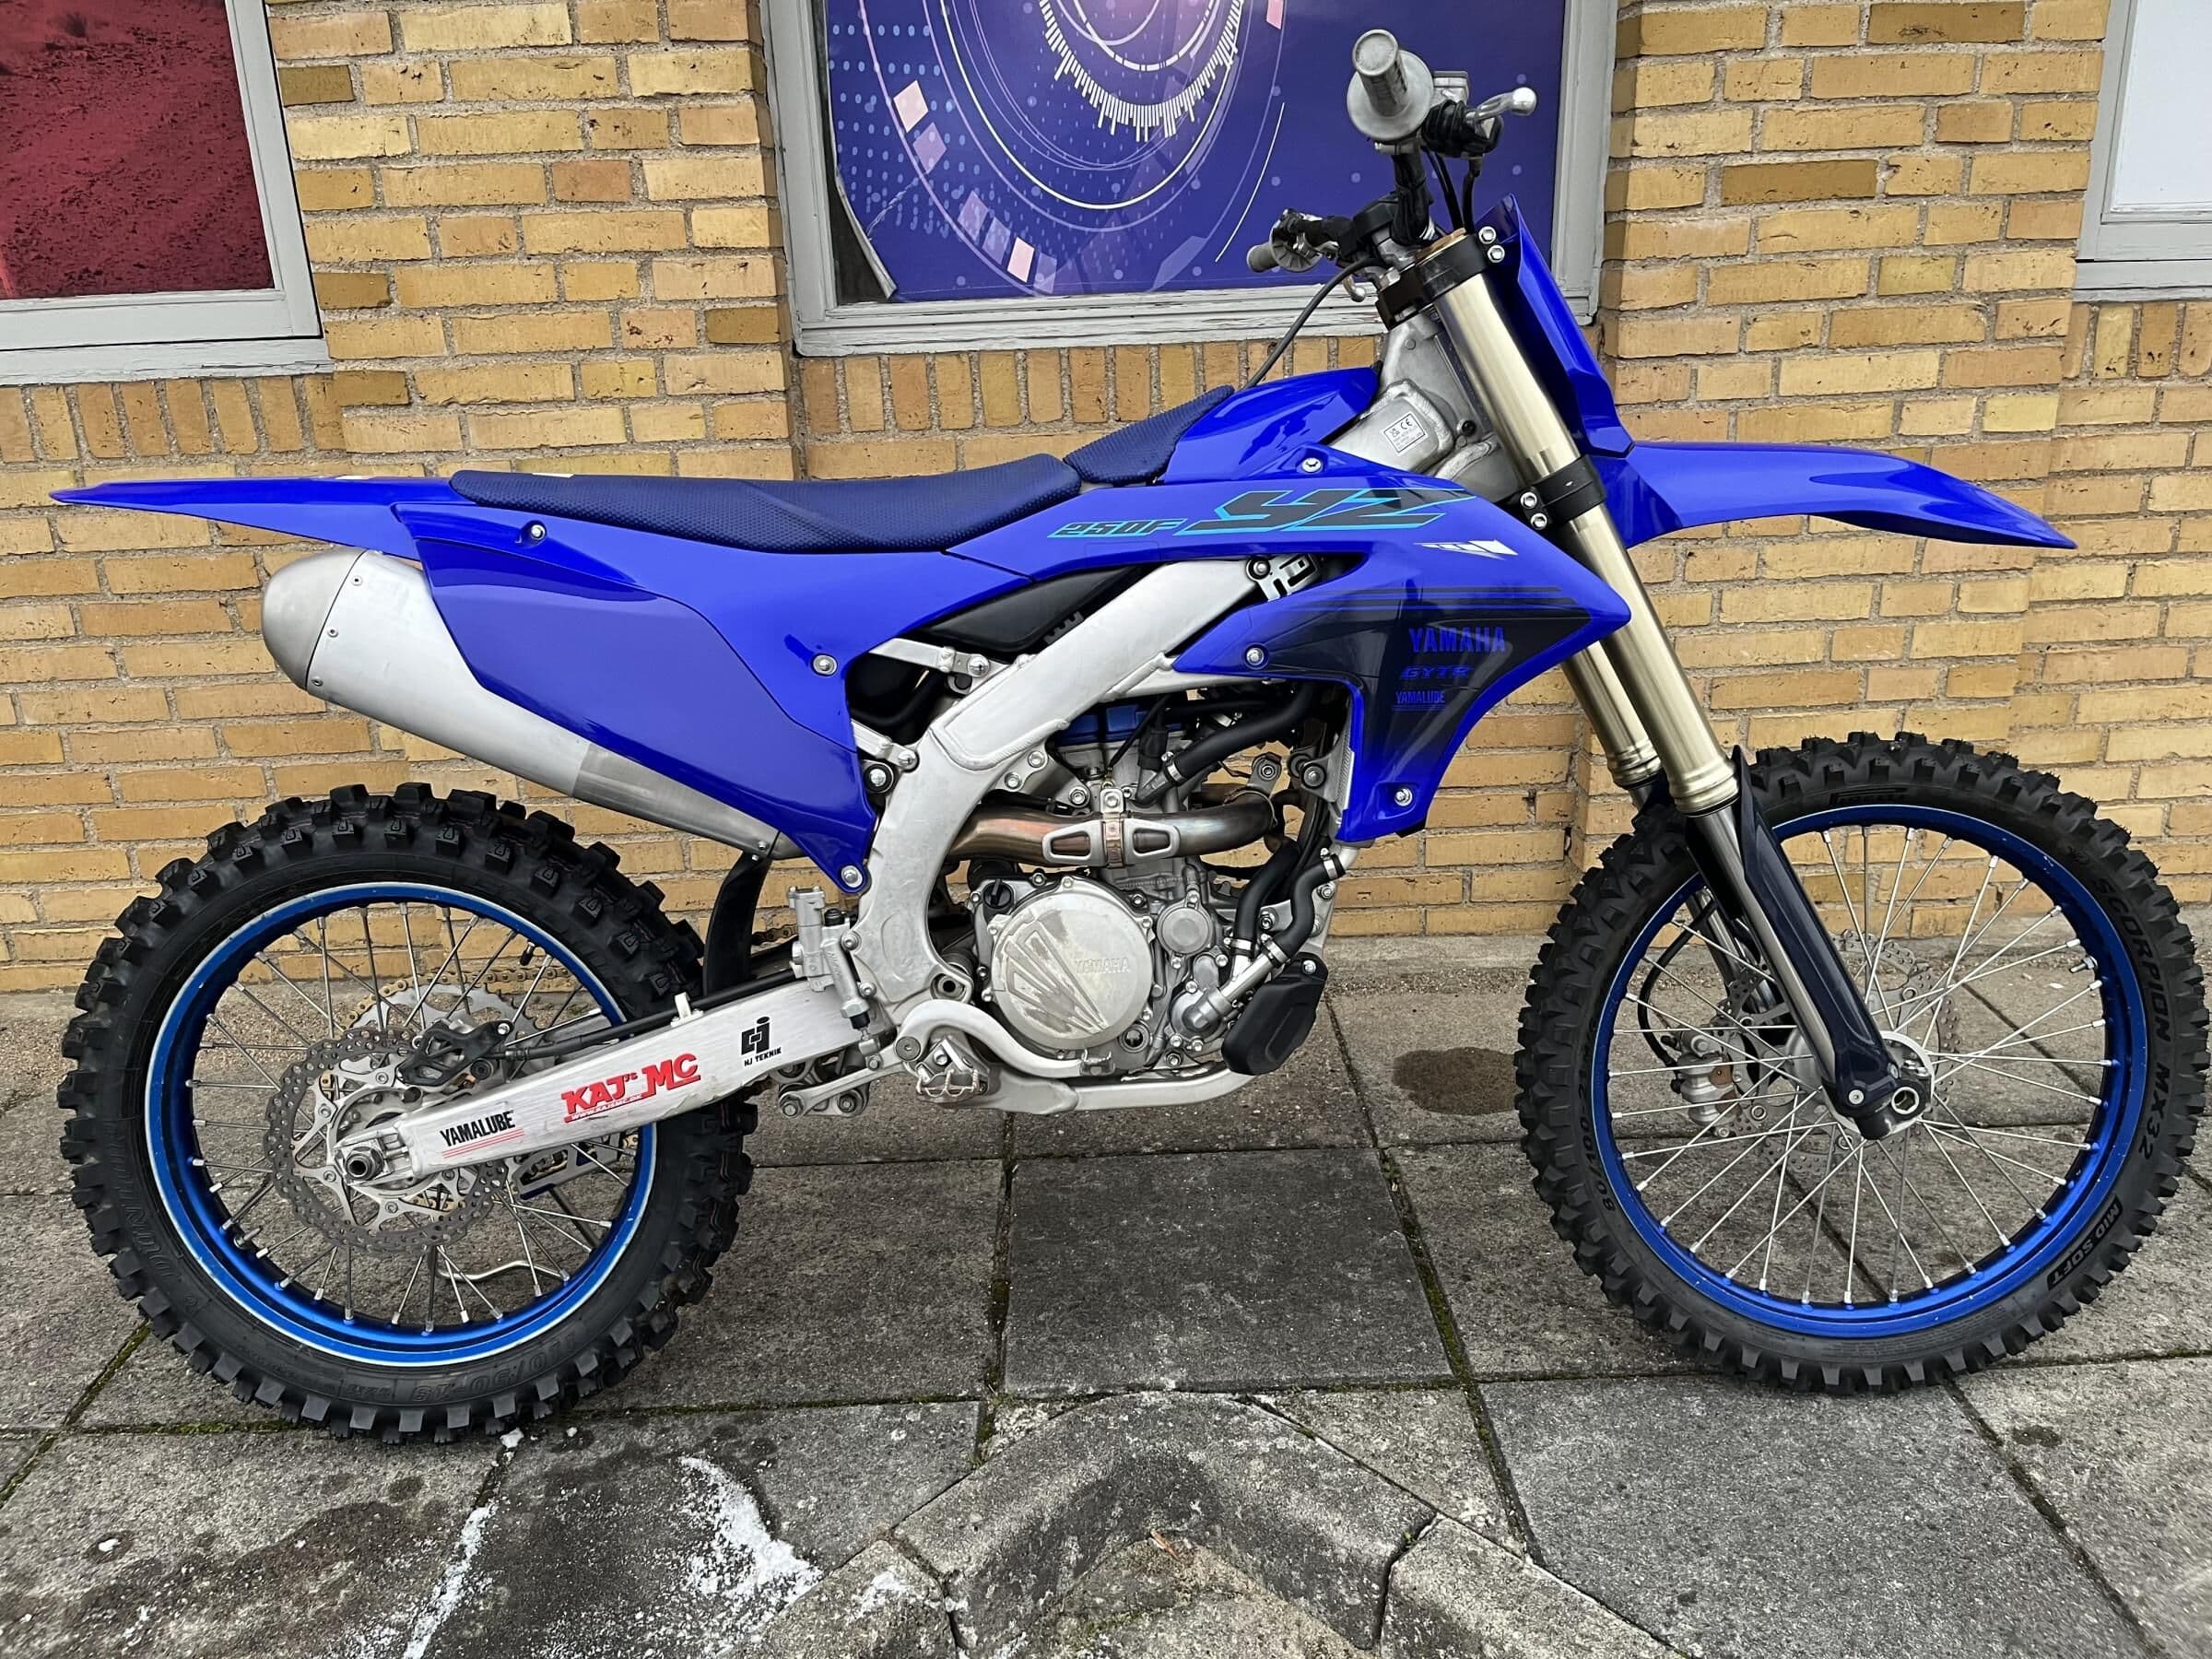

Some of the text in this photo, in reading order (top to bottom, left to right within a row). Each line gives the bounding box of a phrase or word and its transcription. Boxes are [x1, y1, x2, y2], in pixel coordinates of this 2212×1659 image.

[1047, 488, 1477, 538] 250F YZ
[1408, 626, 1506, 653] YAMAHA
[1401, 665, 1471, 679] GYTR
[1394, 689, 1446, 704] YAMALUBE
[2095, 877, 2172, 1161] SCORPION MX32
[755, 1046, 782, 1063] TEKNIK
[641, 1053, 701, 1099] MC
[440, 1110, 516, 1147] YAMALUBE
[2052, 1202, 2121, 1285] MID SOFT
